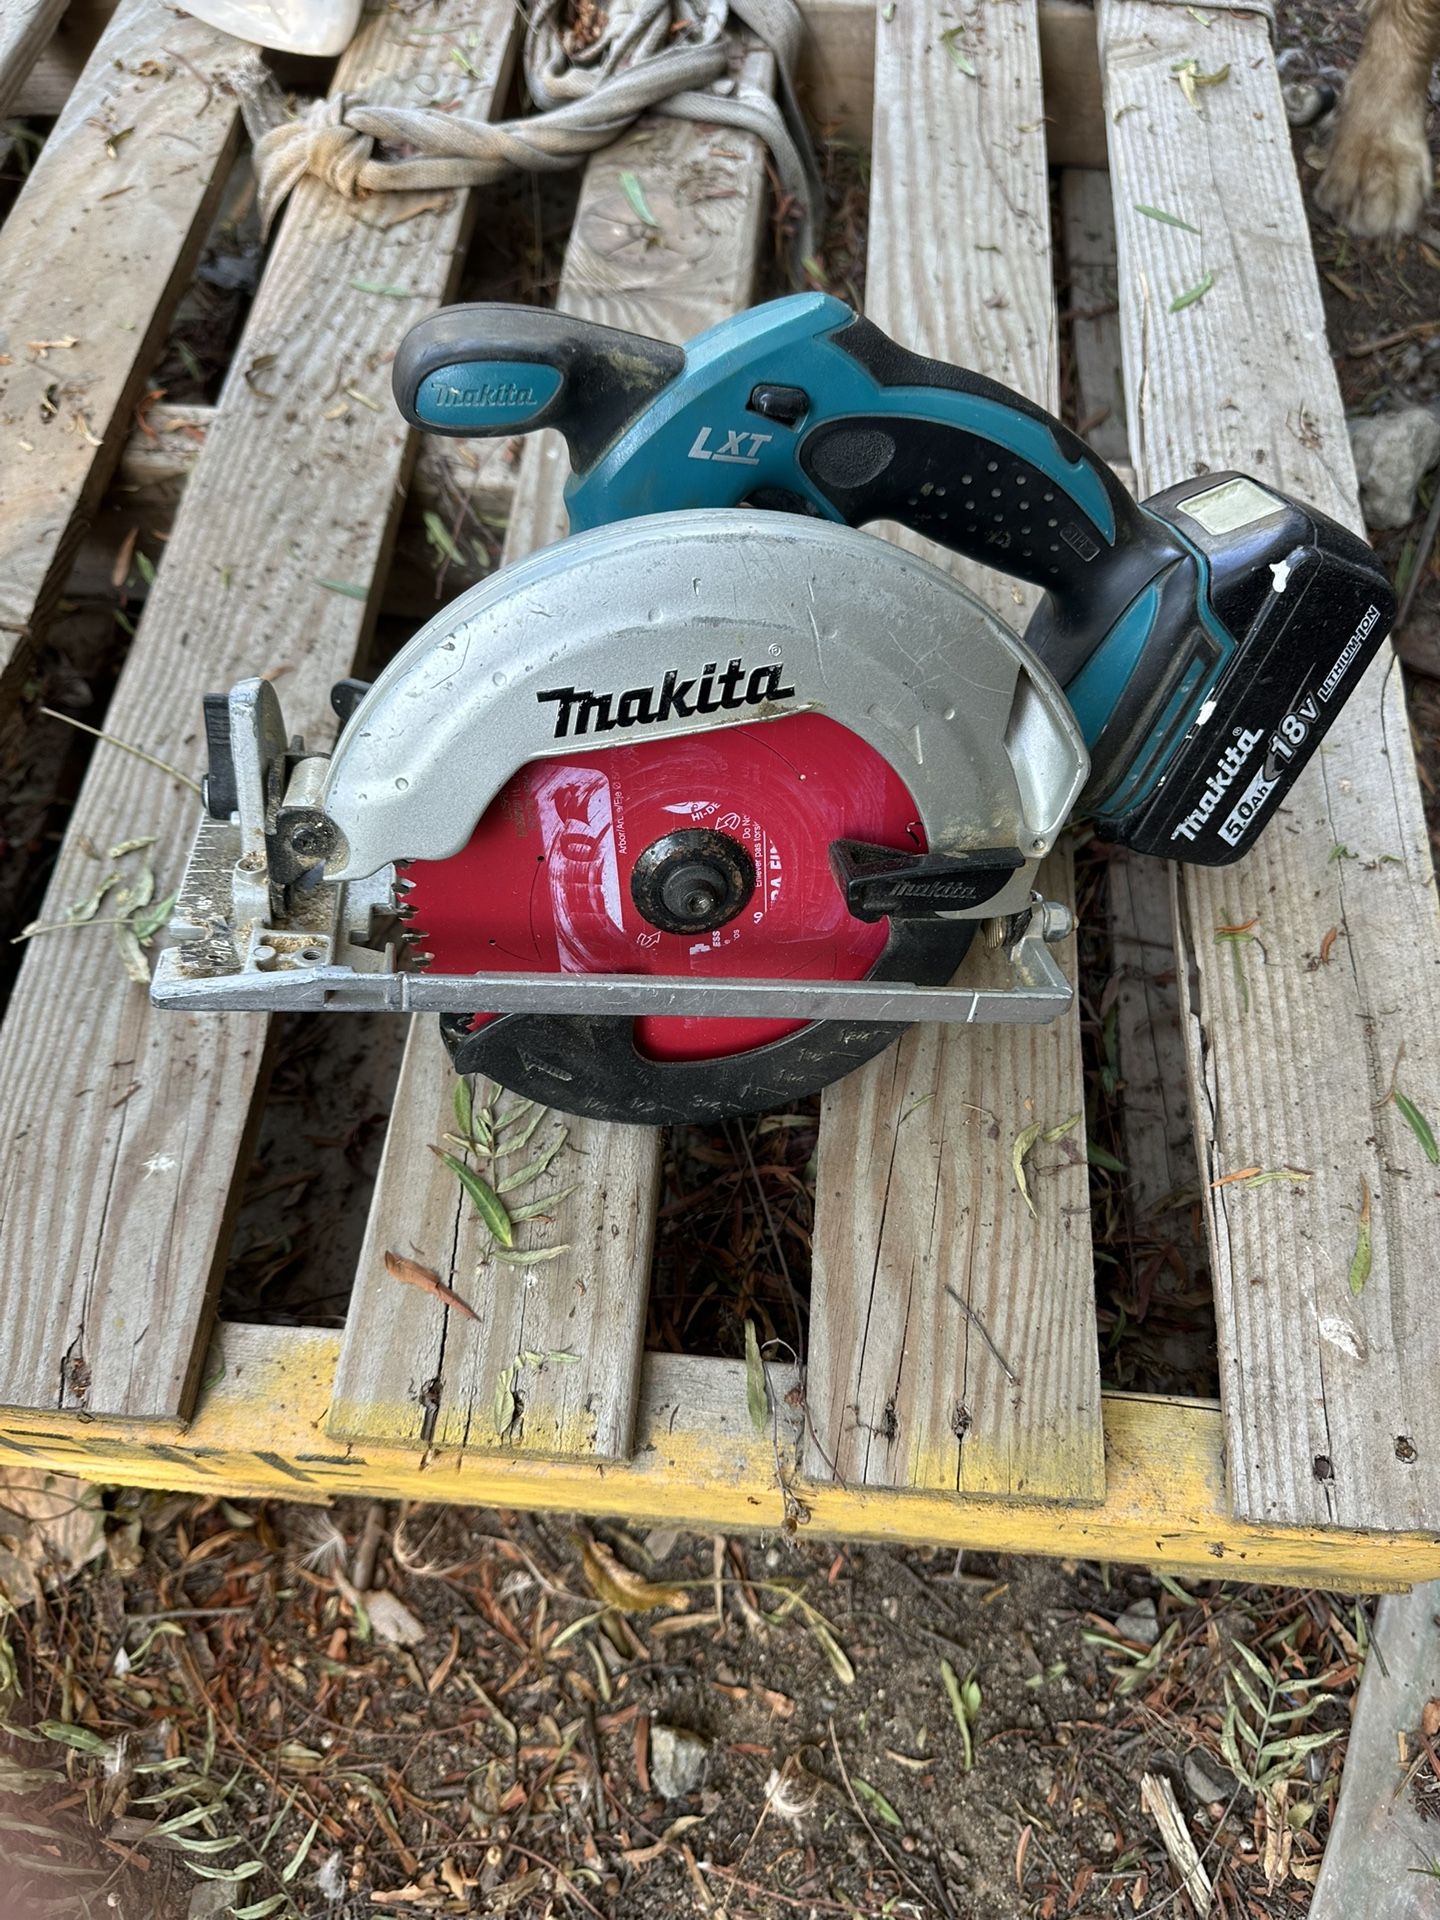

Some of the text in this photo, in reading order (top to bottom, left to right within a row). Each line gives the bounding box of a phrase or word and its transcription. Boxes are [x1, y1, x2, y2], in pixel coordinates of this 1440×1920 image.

[688, 426, 773, 465] LXT
[1317, 605, 1381, 702] LITHIUM-ION
[1224, 785, 1270, 839] 5.0Ah
[742, 827, 751, 839] Do
[755, 842, 764, 857] pas
